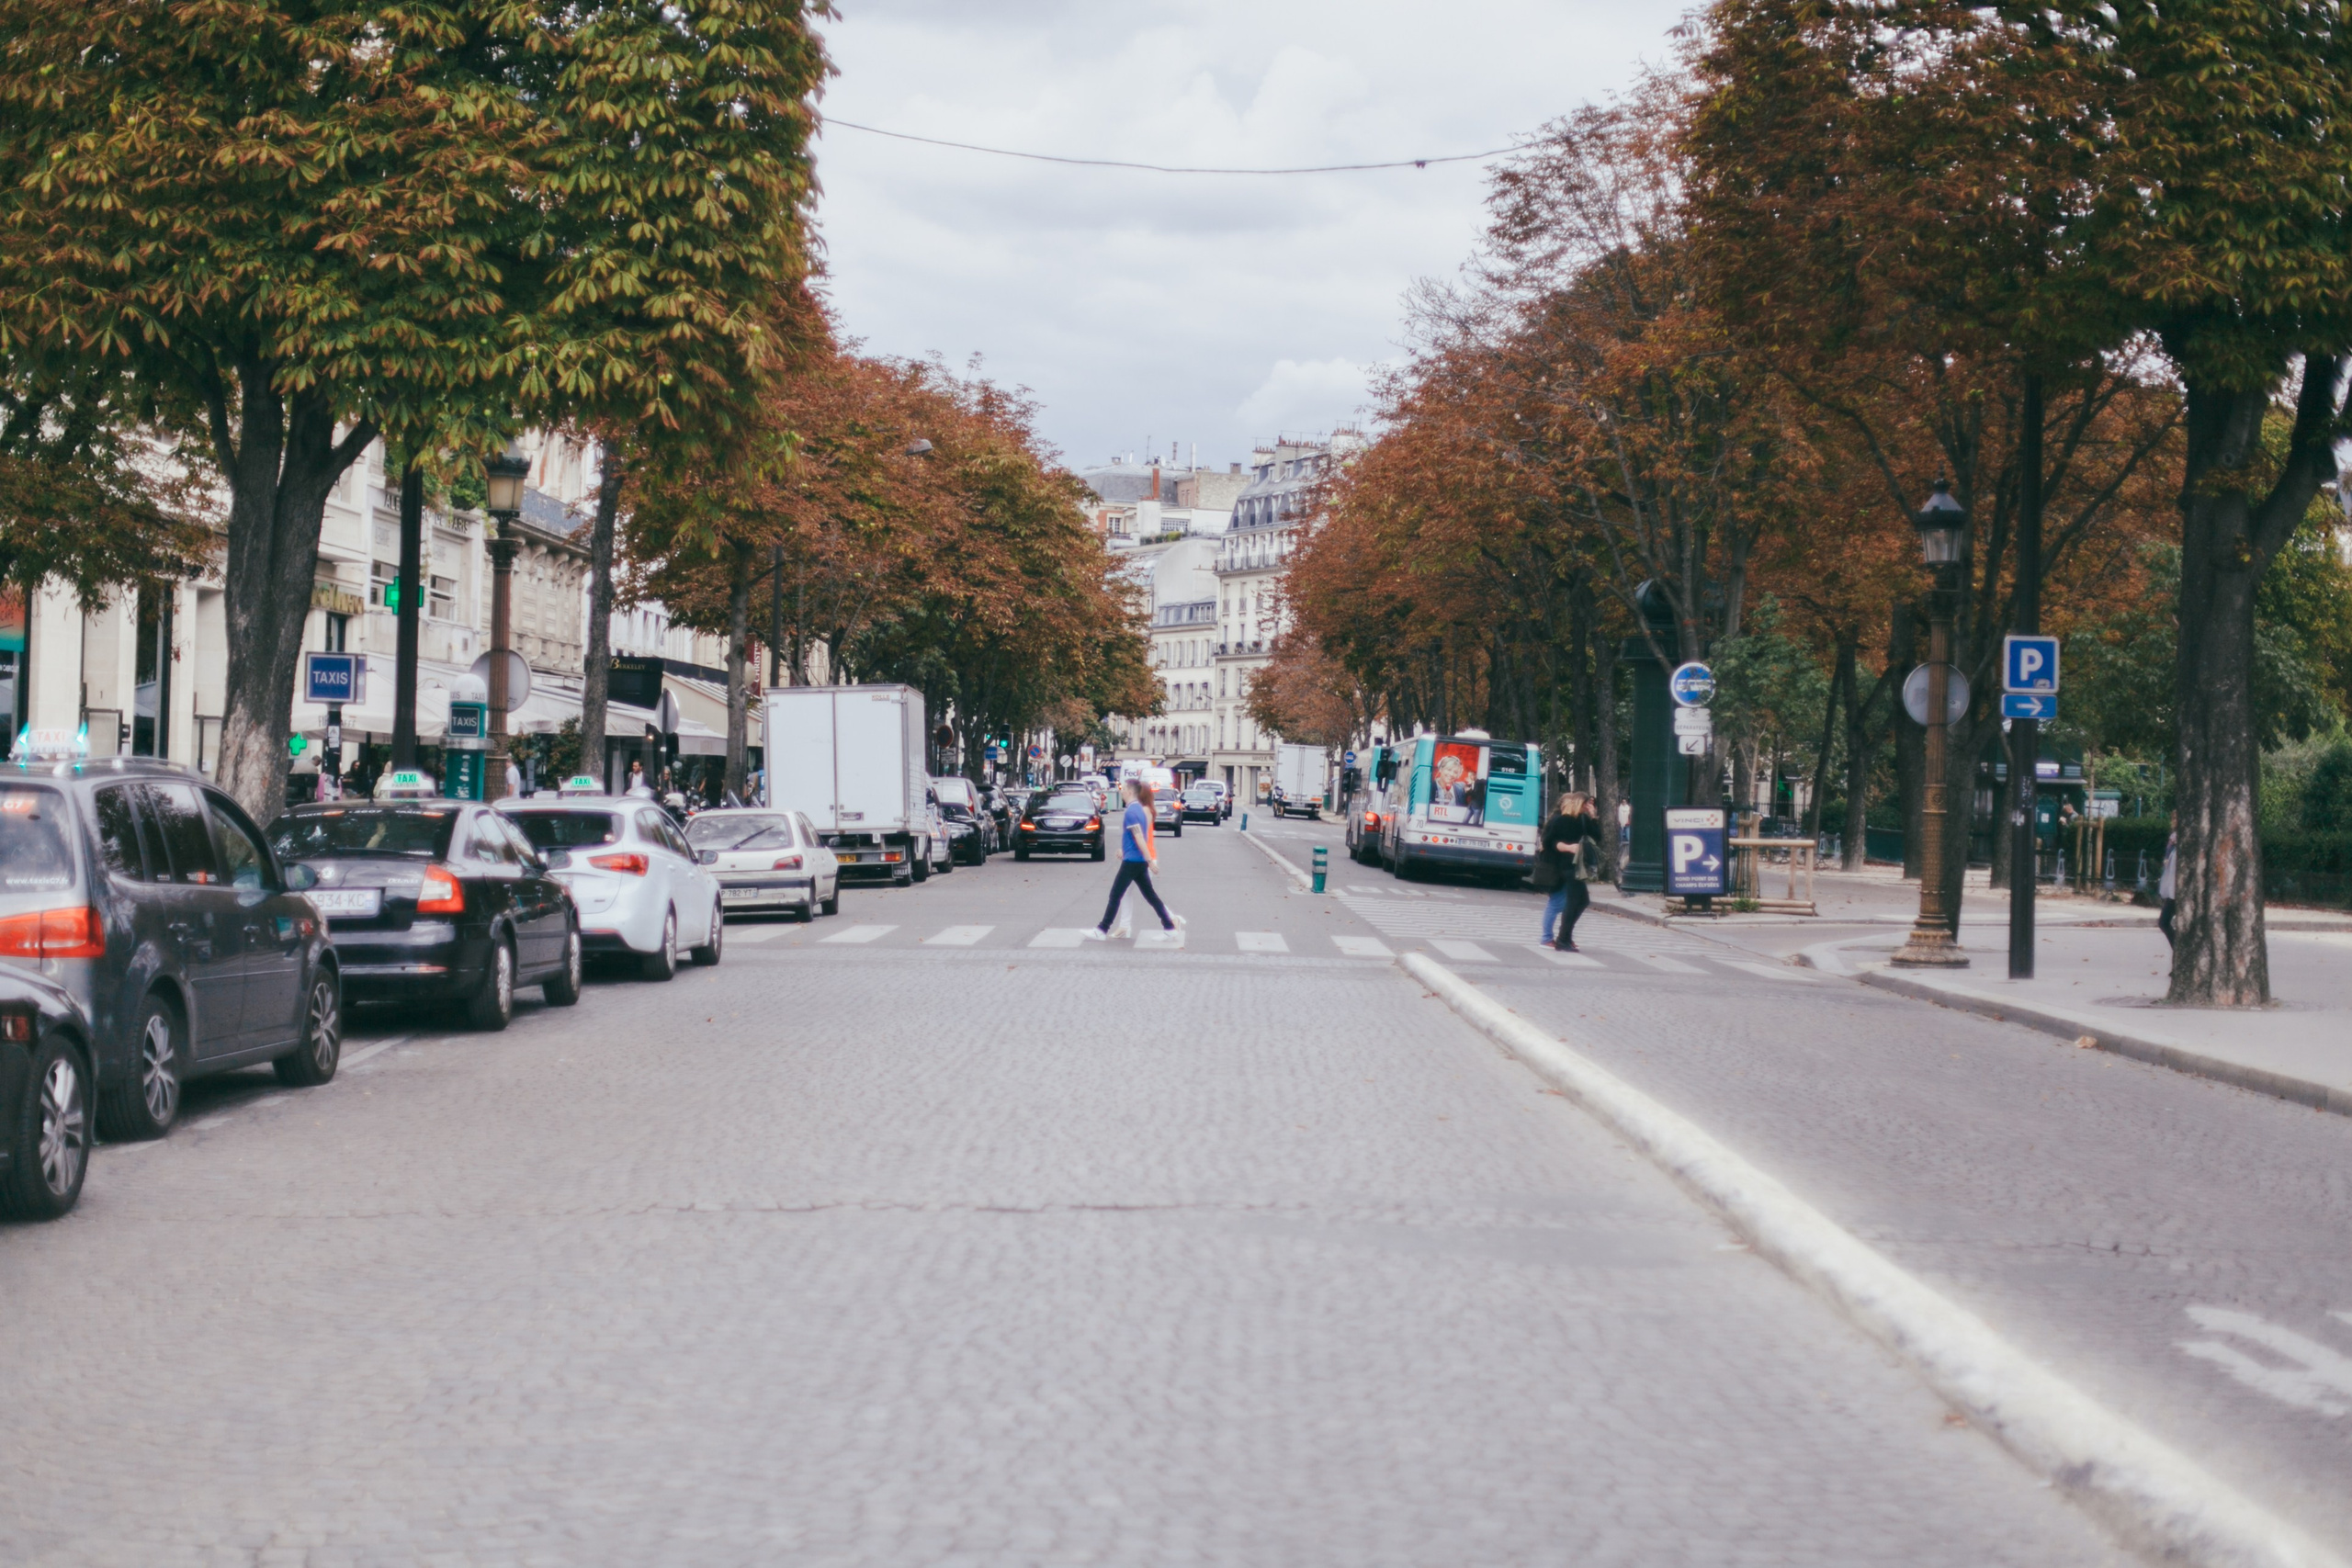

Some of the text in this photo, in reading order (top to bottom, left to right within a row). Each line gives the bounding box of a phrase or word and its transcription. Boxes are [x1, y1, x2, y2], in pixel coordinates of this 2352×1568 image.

[2020, 648, 2043, 682] P
[312, 671, 348, 685] TAXIS
[452, 716, 477, 727] TAXIS
[37, 731, 66, 742] TAXI
[397, 773, 417, 782] TAXI
[574, 777, 591, 785] TAXI
[1434, 807, 1448, 817] RTL
[1416, 818, 1424, 829] 70
[1673, 835, 1703, 874] P
